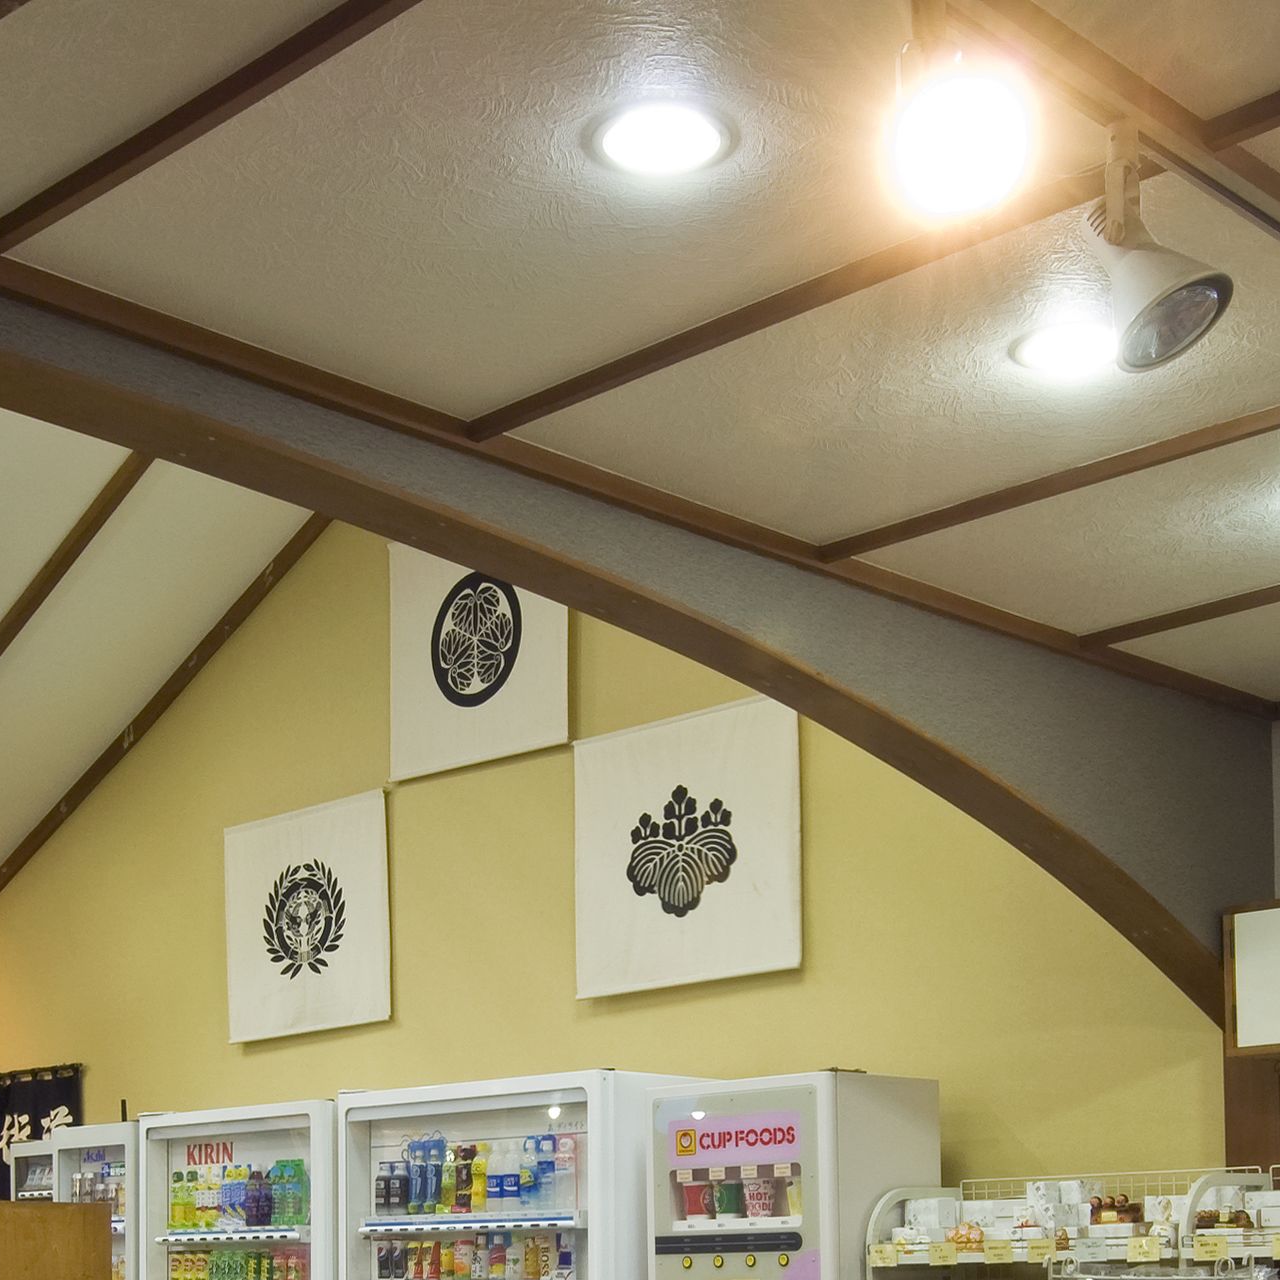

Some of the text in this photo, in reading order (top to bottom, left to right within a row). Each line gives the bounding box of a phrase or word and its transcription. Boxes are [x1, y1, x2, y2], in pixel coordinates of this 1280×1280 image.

[699, 1126, 796, 1150] CUP FOODS
[187, 1142, 234, 1166] KIRIN
[541, 1247, 549, 1277] BOSS
